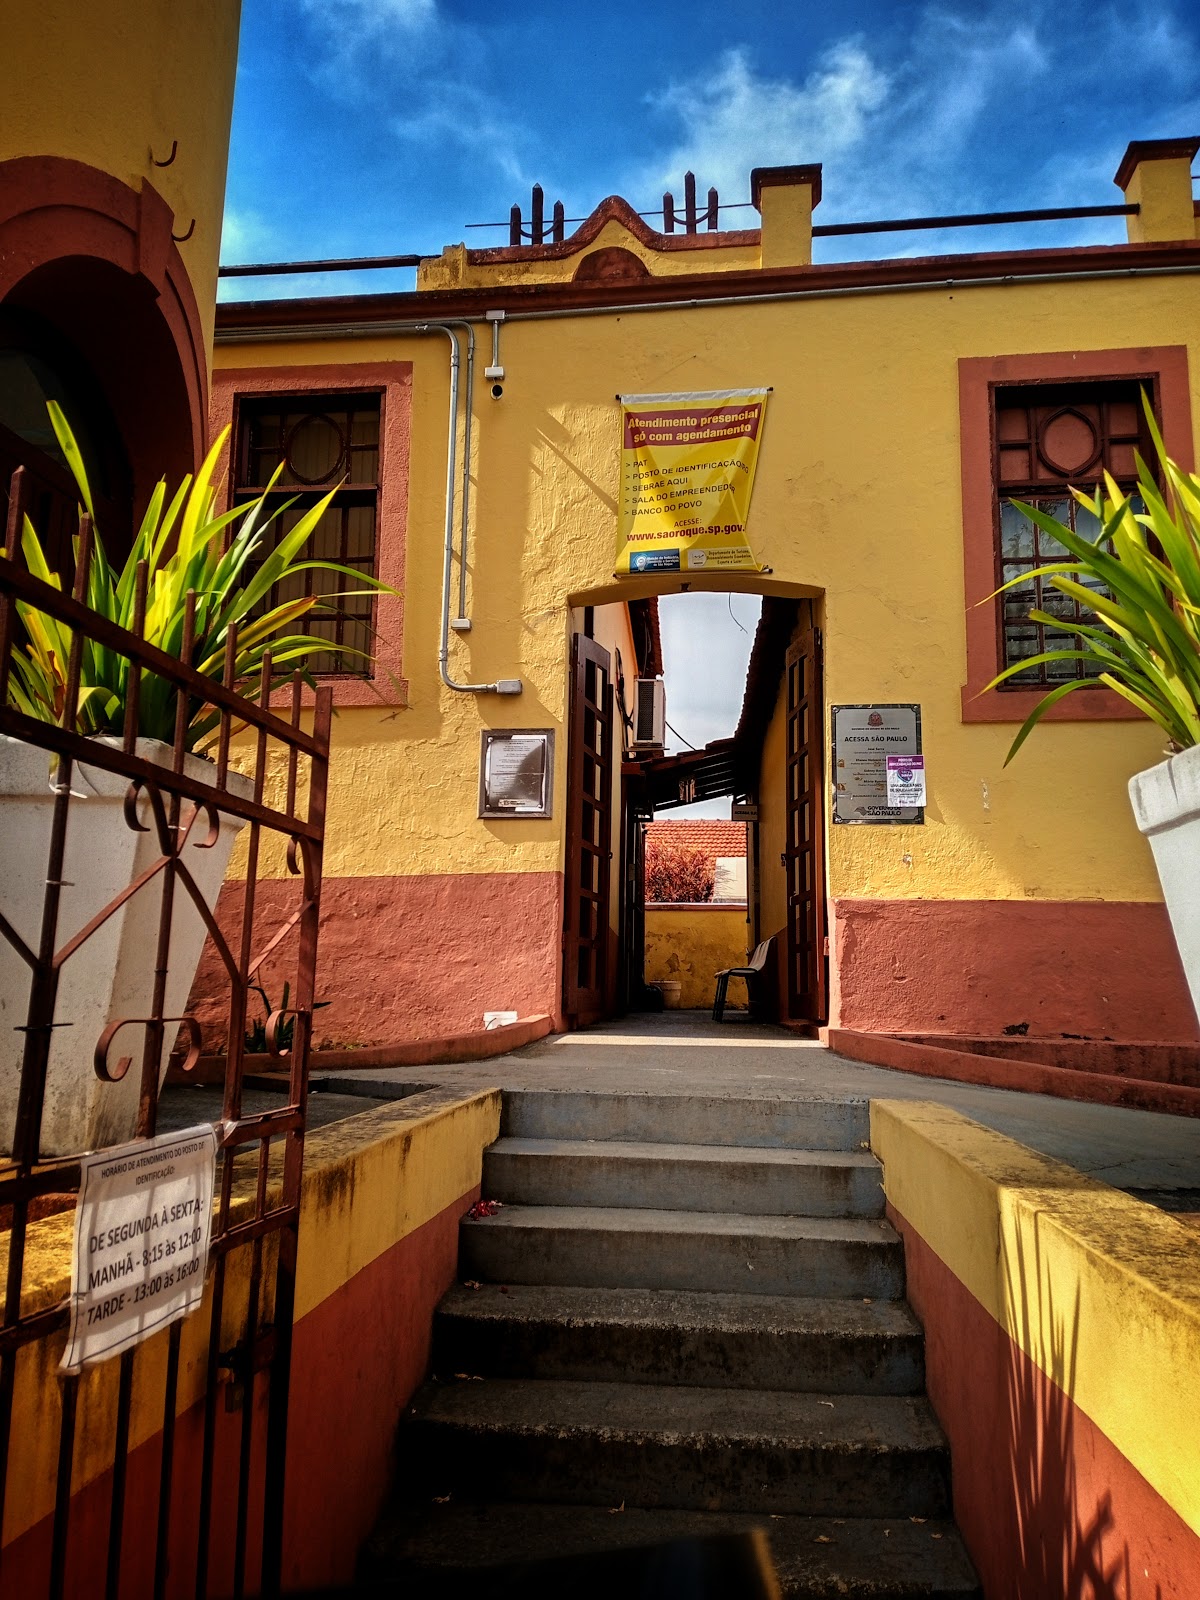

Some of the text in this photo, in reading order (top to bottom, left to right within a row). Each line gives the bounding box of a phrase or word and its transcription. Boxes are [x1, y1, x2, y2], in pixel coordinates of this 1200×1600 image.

[628, 409, 758, 429] Atendimento presencial
[634, 424, 751, 443] só com agendamento
[633, 459, 648, 468] PAT
[632, 469, 660, 480] POSTO
[632, 477, 688, 492] SEBRAE AQUI
[632, 496, 654, 504] SALA
[656, 492, 668, 501] DO
[631, 500, 702, 516] BANCO DO POVO
[674, 518, 702, 528] ACESSE:
[101, 1141, 204, 1179] HORÁRIO DE ATENDIMENTO DO POSTO DE
[135, 1165, 175, 1186] IDENTIFICAÇÃO:
[89, 1198, 204, 1254] DE SEGUNDA À SEXTA:
[88, 1251, 134, 1291] MANHÃ
[142, 1243, 163, 1267] 8:15
[165, 1240, 176, 1256] às
[178, 1227, 201, 1251] 12:00
[87, 1293, 125, 1326] TARDE
[133, 1276, 162, 1304] 13:00
[164, 1272, 174, 1289] às
[176, 1258, 200, 1283] 16:00
